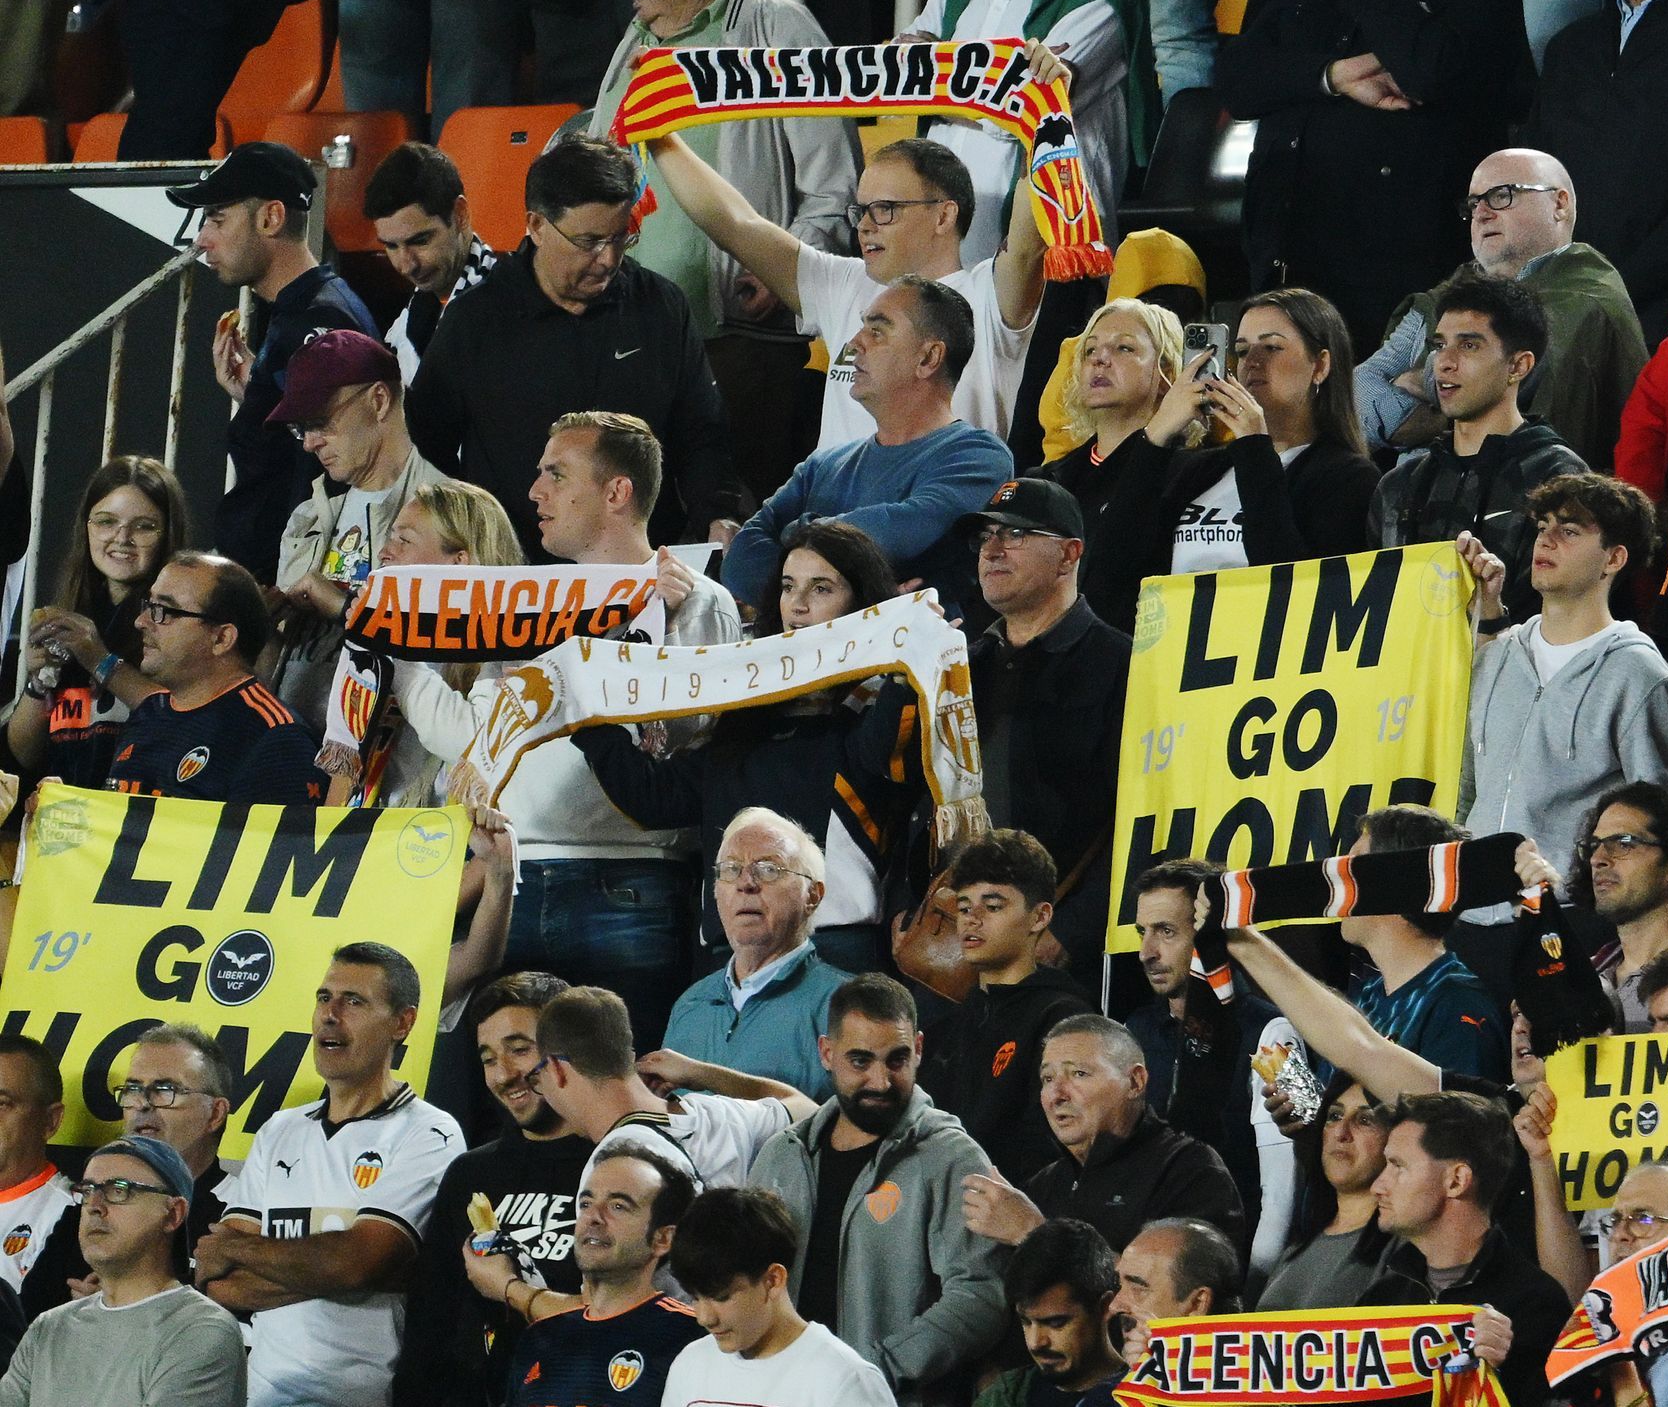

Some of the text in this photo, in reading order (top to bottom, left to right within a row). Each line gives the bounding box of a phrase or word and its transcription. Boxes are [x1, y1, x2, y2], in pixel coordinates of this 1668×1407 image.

[676, 42, 938, 106] VALENCIA
[1173, 526, 1243, 545] martphon
[346, 575, 588, 650] VALENCIA
[1179, 548, 1404, 693] LIM
[1226, 688, 1338, 780] GO
[92, 794, 385, 919] LIM
[216, 970, 260, 983] LIBERTAD
[226, 980, 245, 991] VCF
[0, 1010, 408, 1135] HOM
[271, 1218, 304, 1240] TM
[535, 1230, 576, 1261] SB
[1134, 1328, 1392, 1394] ALENCIA
